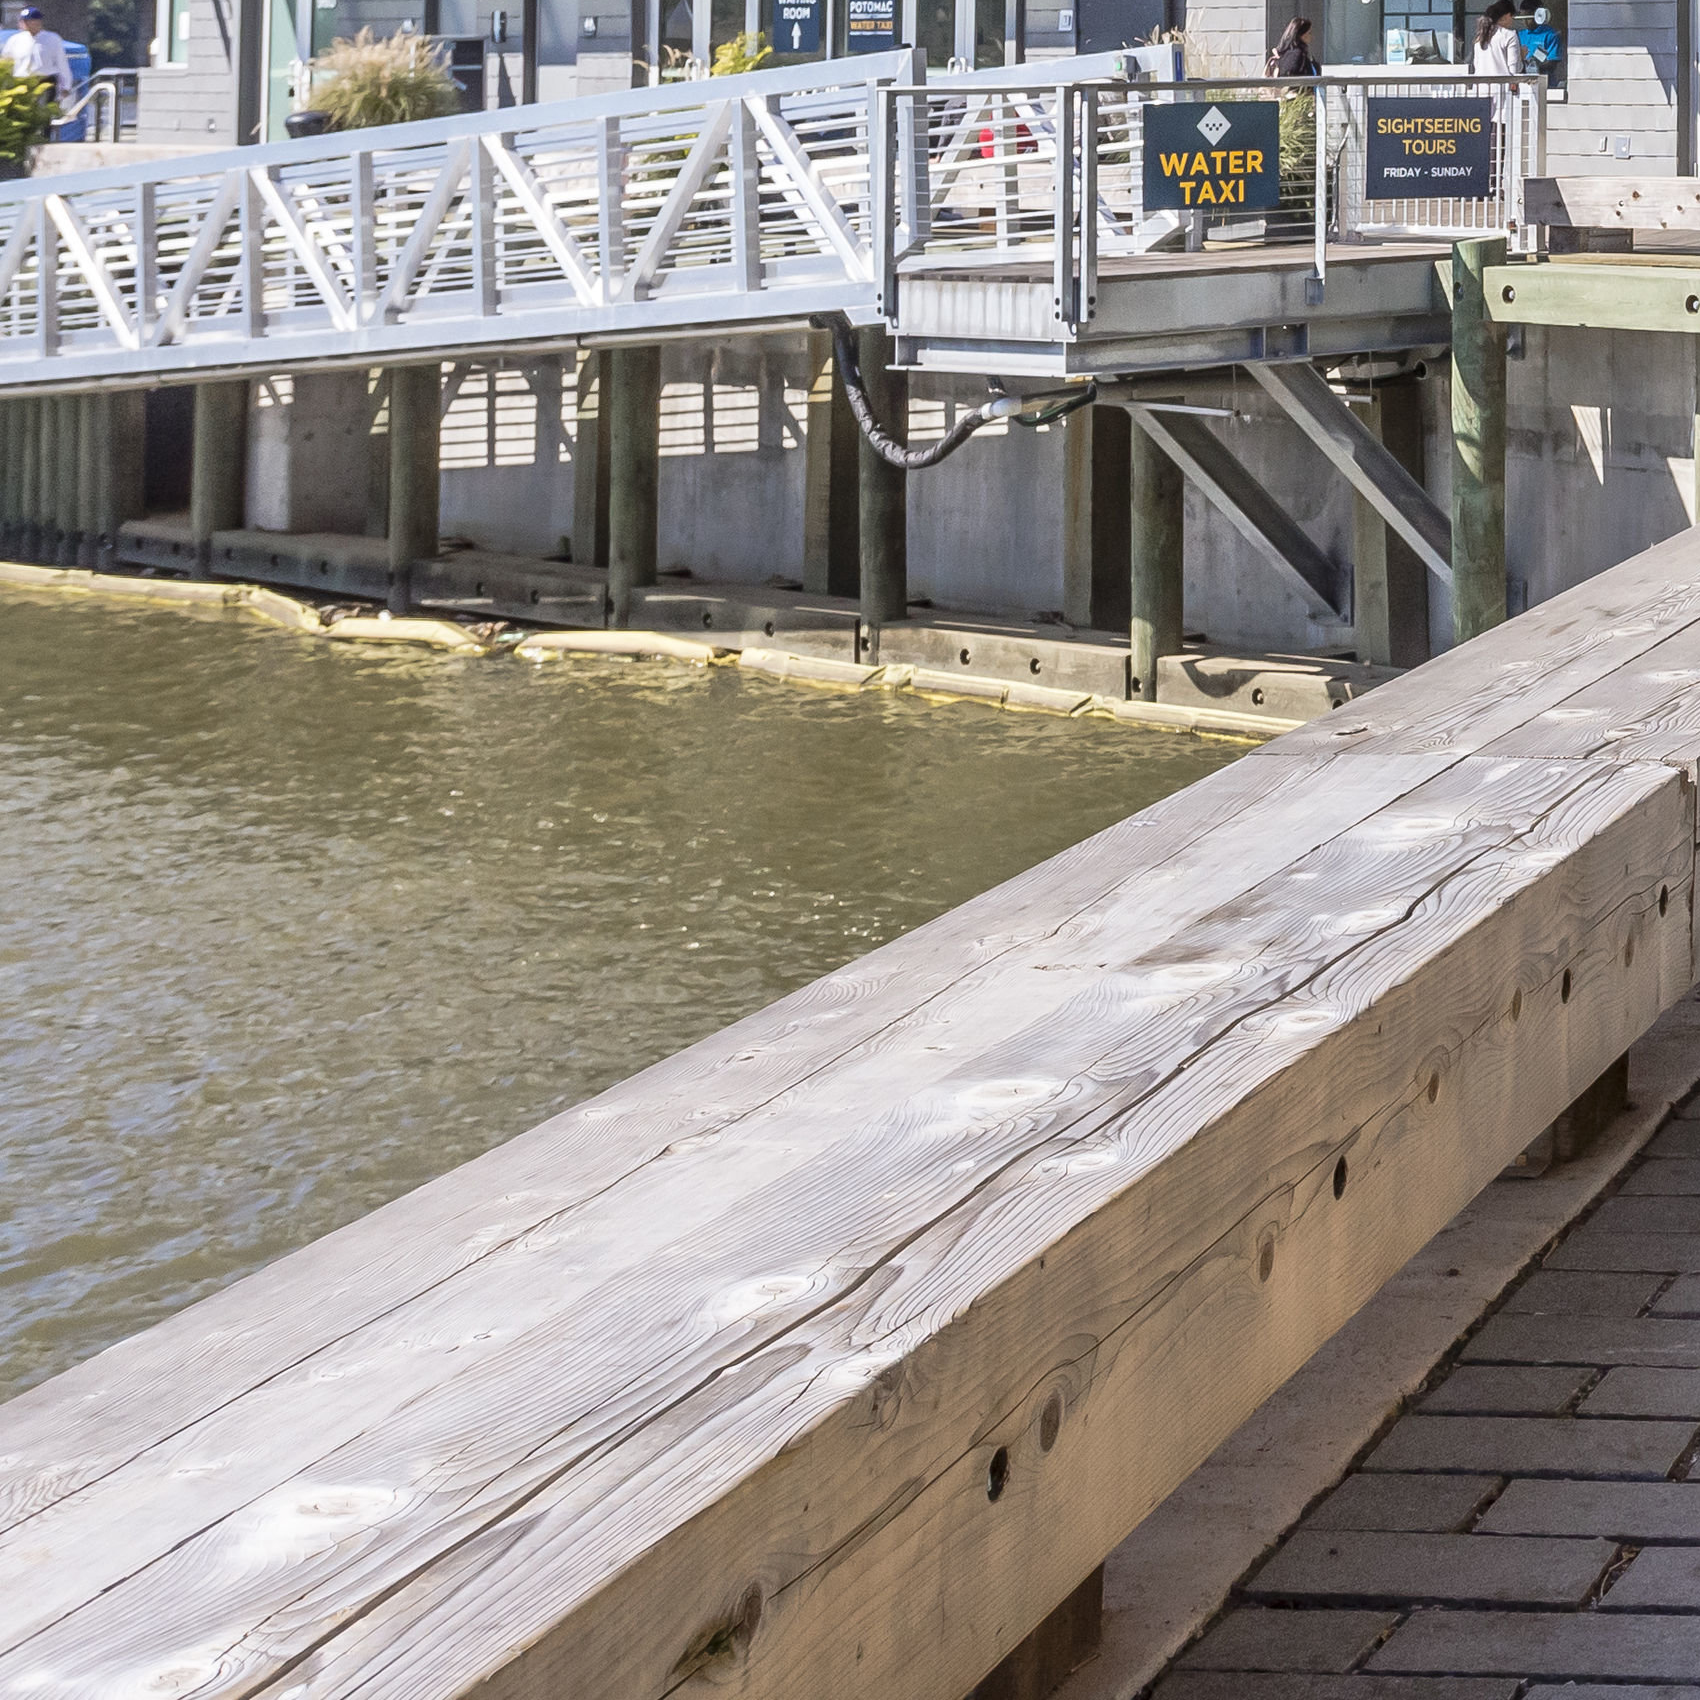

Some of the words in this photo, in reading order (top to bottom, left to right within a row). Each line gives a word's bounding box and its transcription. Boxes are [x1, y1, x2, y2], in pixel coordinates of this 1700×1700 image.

[783, 7, 811, 20] ROOM
[849, 0, 893, 14] POTOMAC
[1377, 118, 1481, 134] SIGHTSEEING
[1402, 139, 1456, 155] TOURS
[1160, 150, 1264, 177] WATER
[1383, 167, 1422, 178] FRIDAY
[1431, 166, 1473, 178] SUNDAY
[1179, 179, 1245, 205] TAXI
